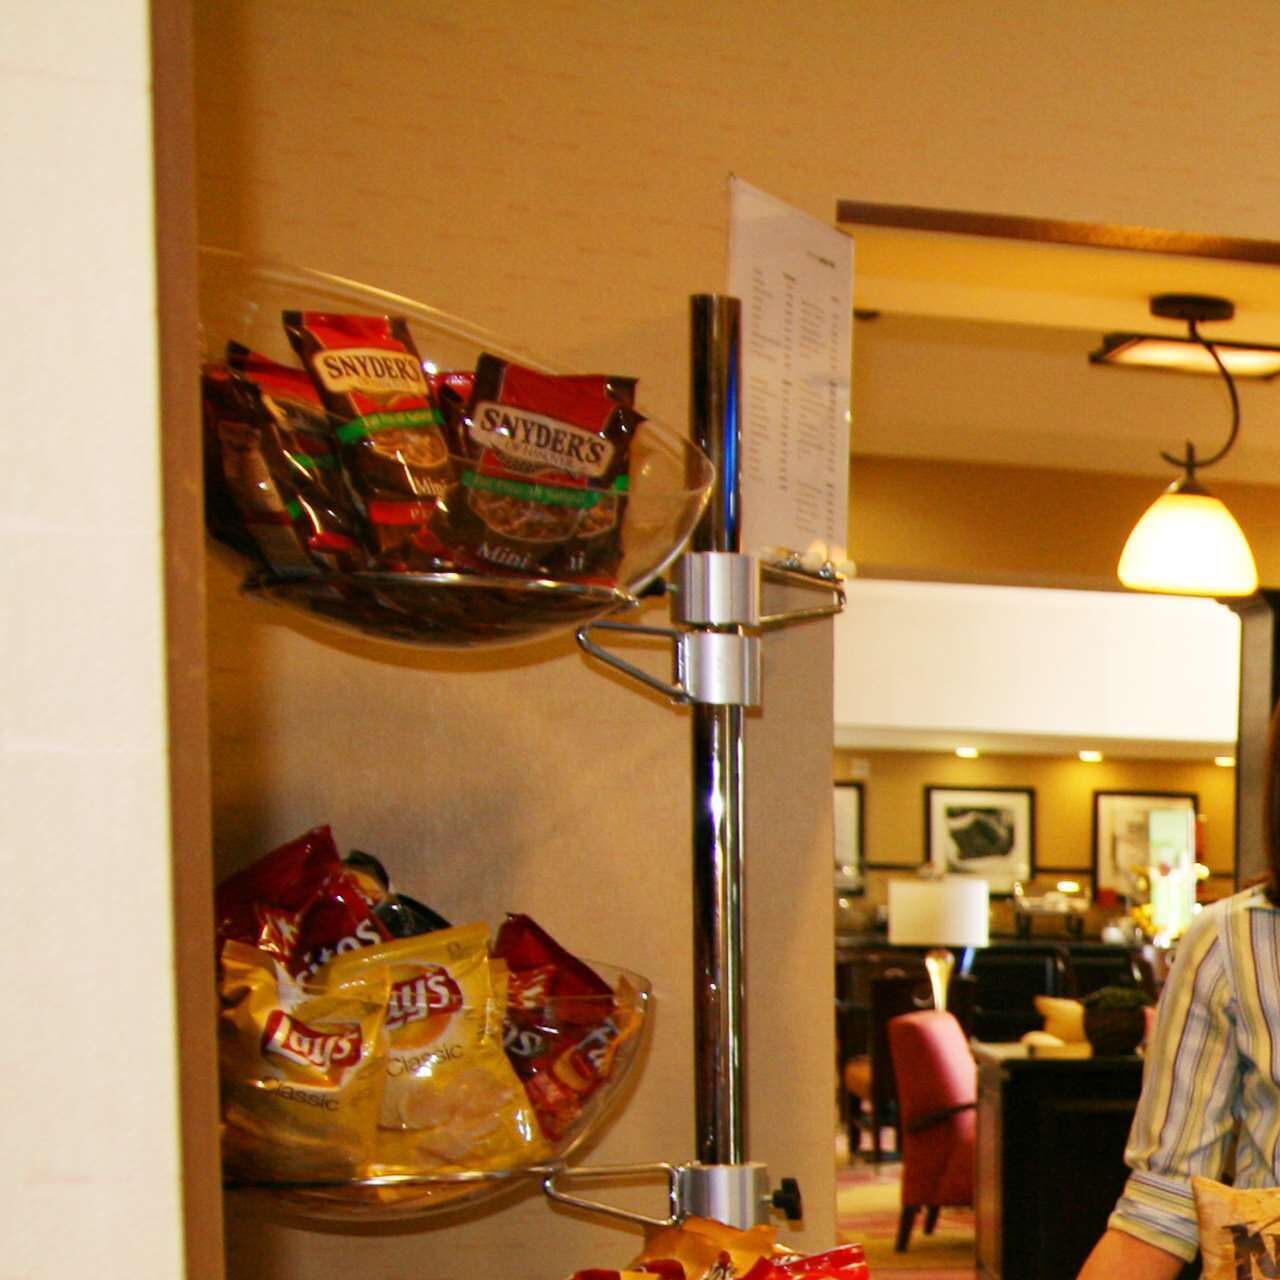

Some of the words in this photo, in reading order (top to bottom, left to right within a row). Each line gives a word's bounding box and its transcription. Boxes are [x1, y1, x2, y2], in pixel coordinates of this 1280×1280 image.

[323, 354, 421, 380] SNYDER'S
[480, 407, 605, 464] SNYDER'S
[477, 542, 530, 569] Mini
[264, 1014, 359, 1072] Lay's
[262, 1075, 340, 1112] Classic
